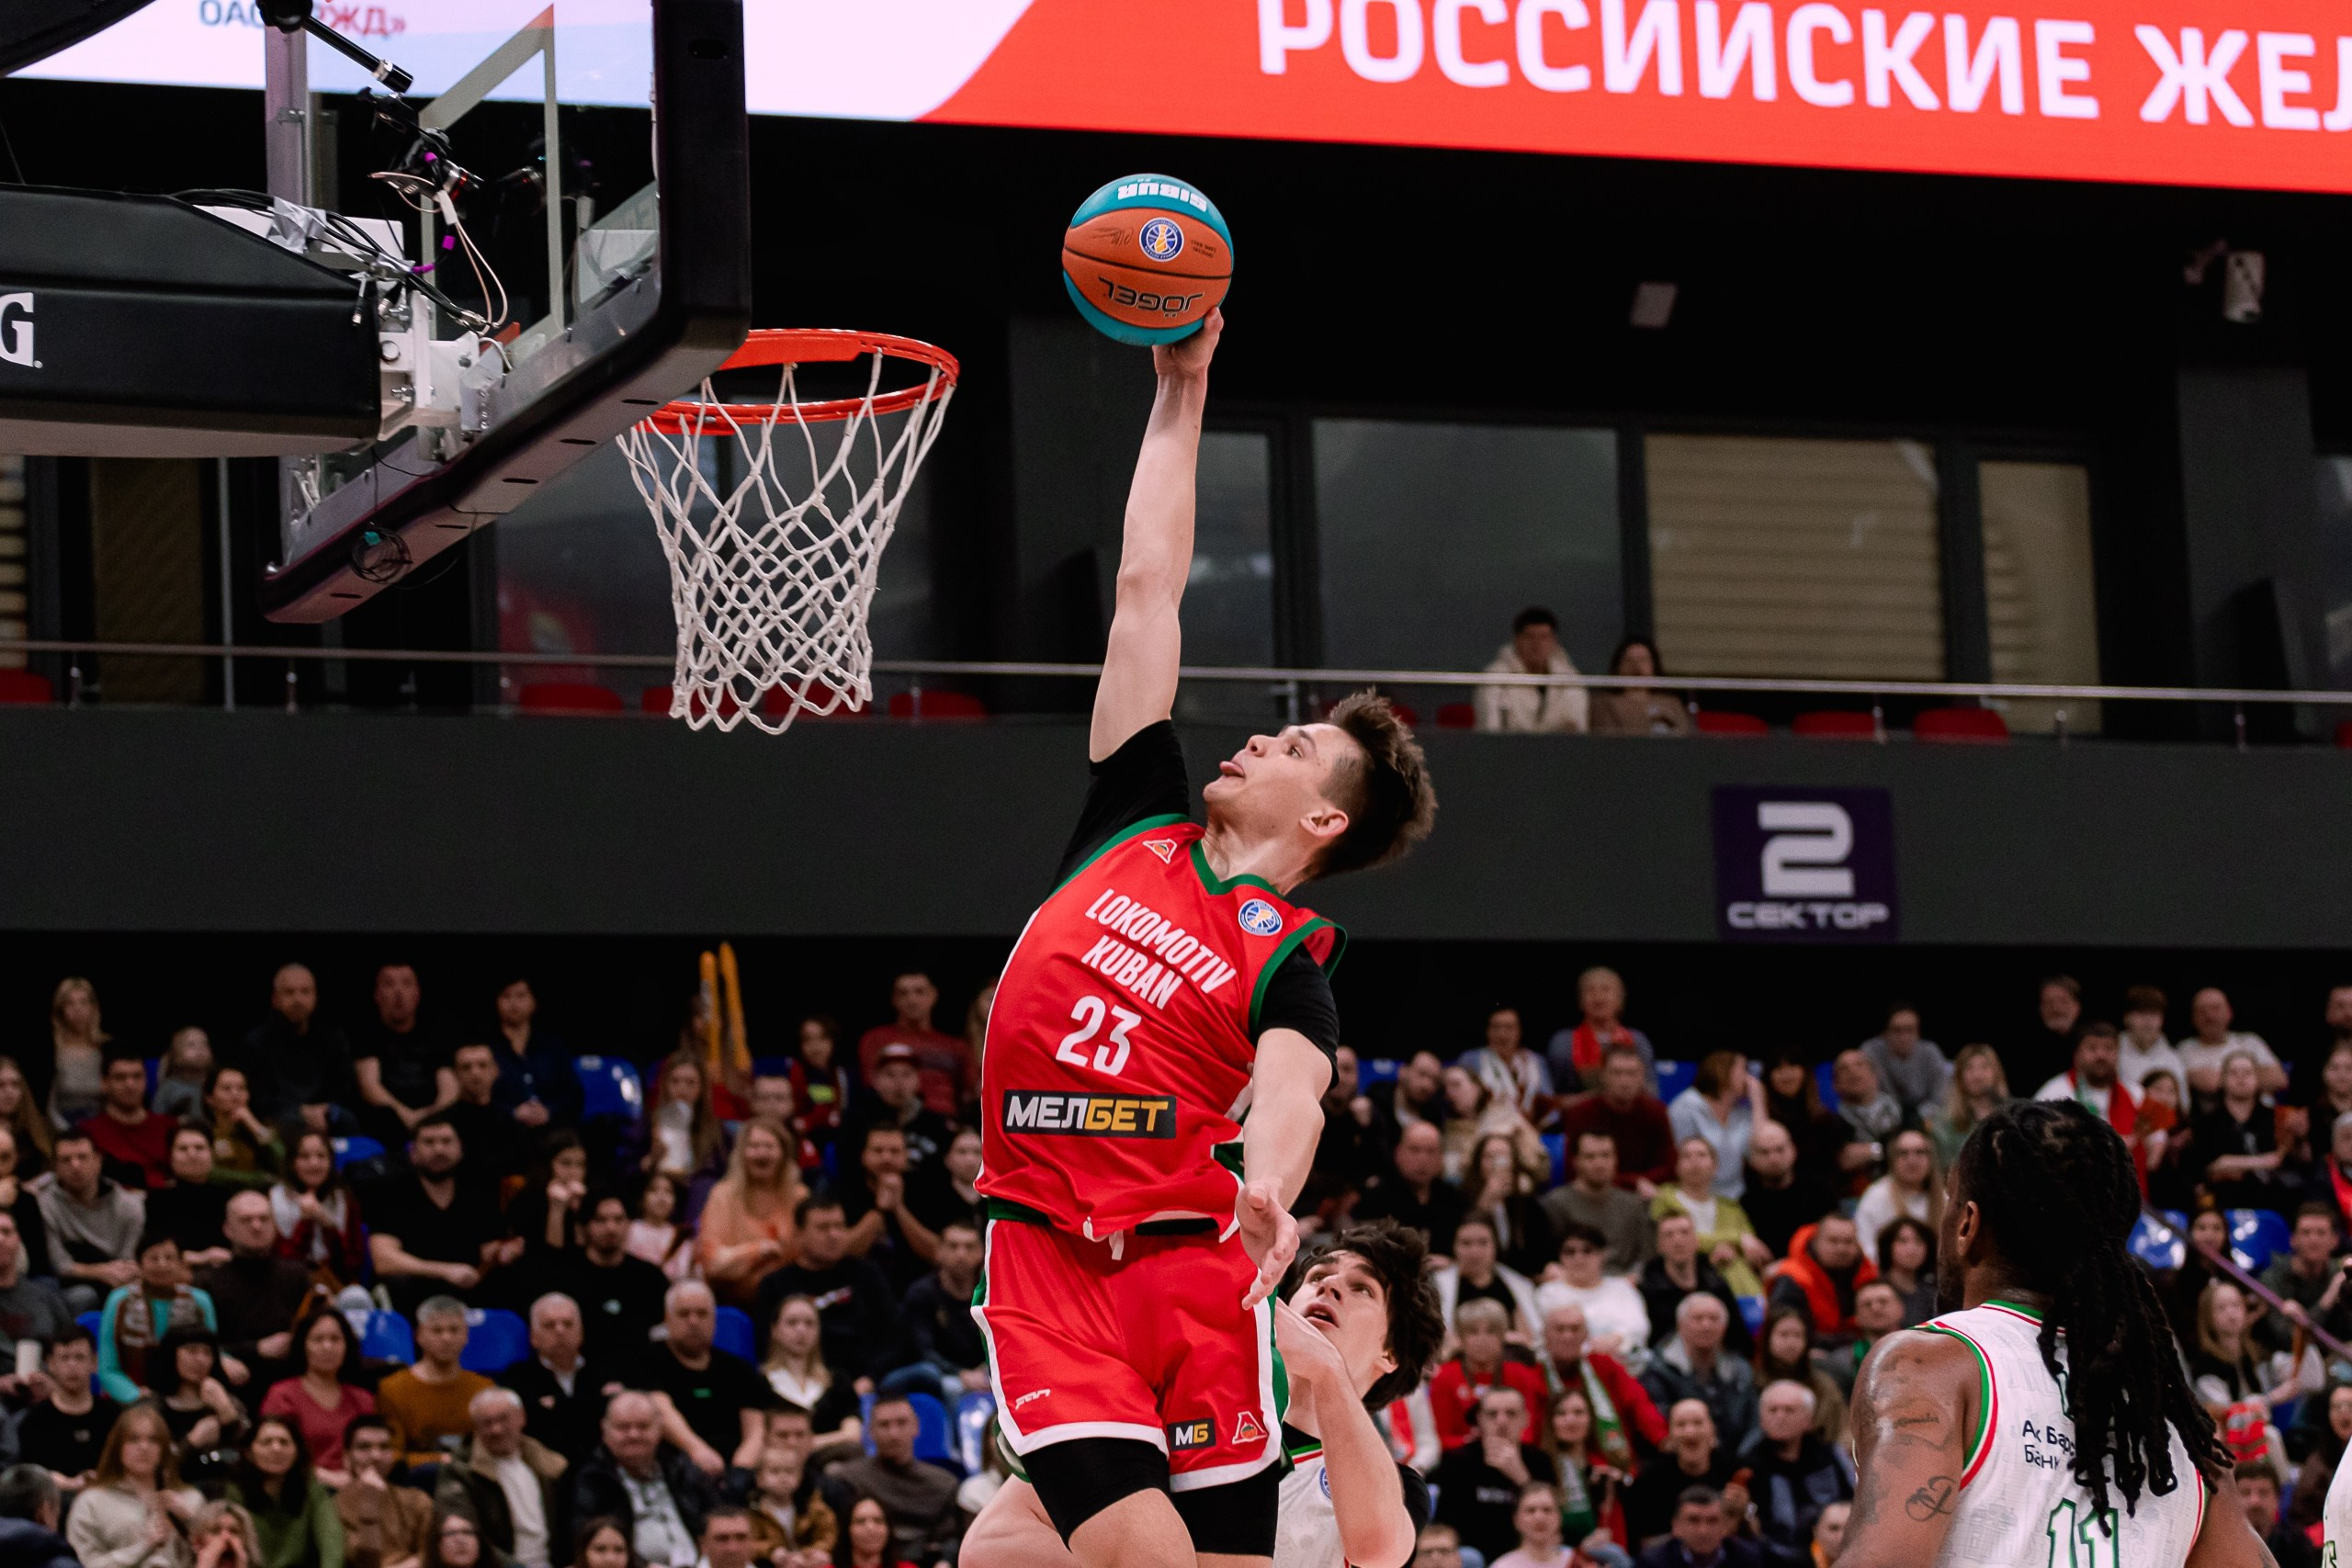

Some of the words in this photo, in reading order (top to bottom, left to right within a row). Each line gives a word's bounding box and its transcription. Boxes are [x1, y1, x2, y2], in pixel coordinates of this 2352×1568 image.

[1118, 183, 1207, 212] SIBUR
[1099, 276, 1204, 317] JÖGEL
[1757, 801, 1855, 898] 2
[1085, 888, 1237, 994] LOKOMOTIV
[1726, 901, 1891, 930] СЕКТОР
[1081, 935, 1183, 1010] KUBAN
[1055, 995, 1142, 1077] 23
[1006, 1095, 1169, 1133] МЕЛБЕТ
[2046, 1497, 2120, 1568] 11
